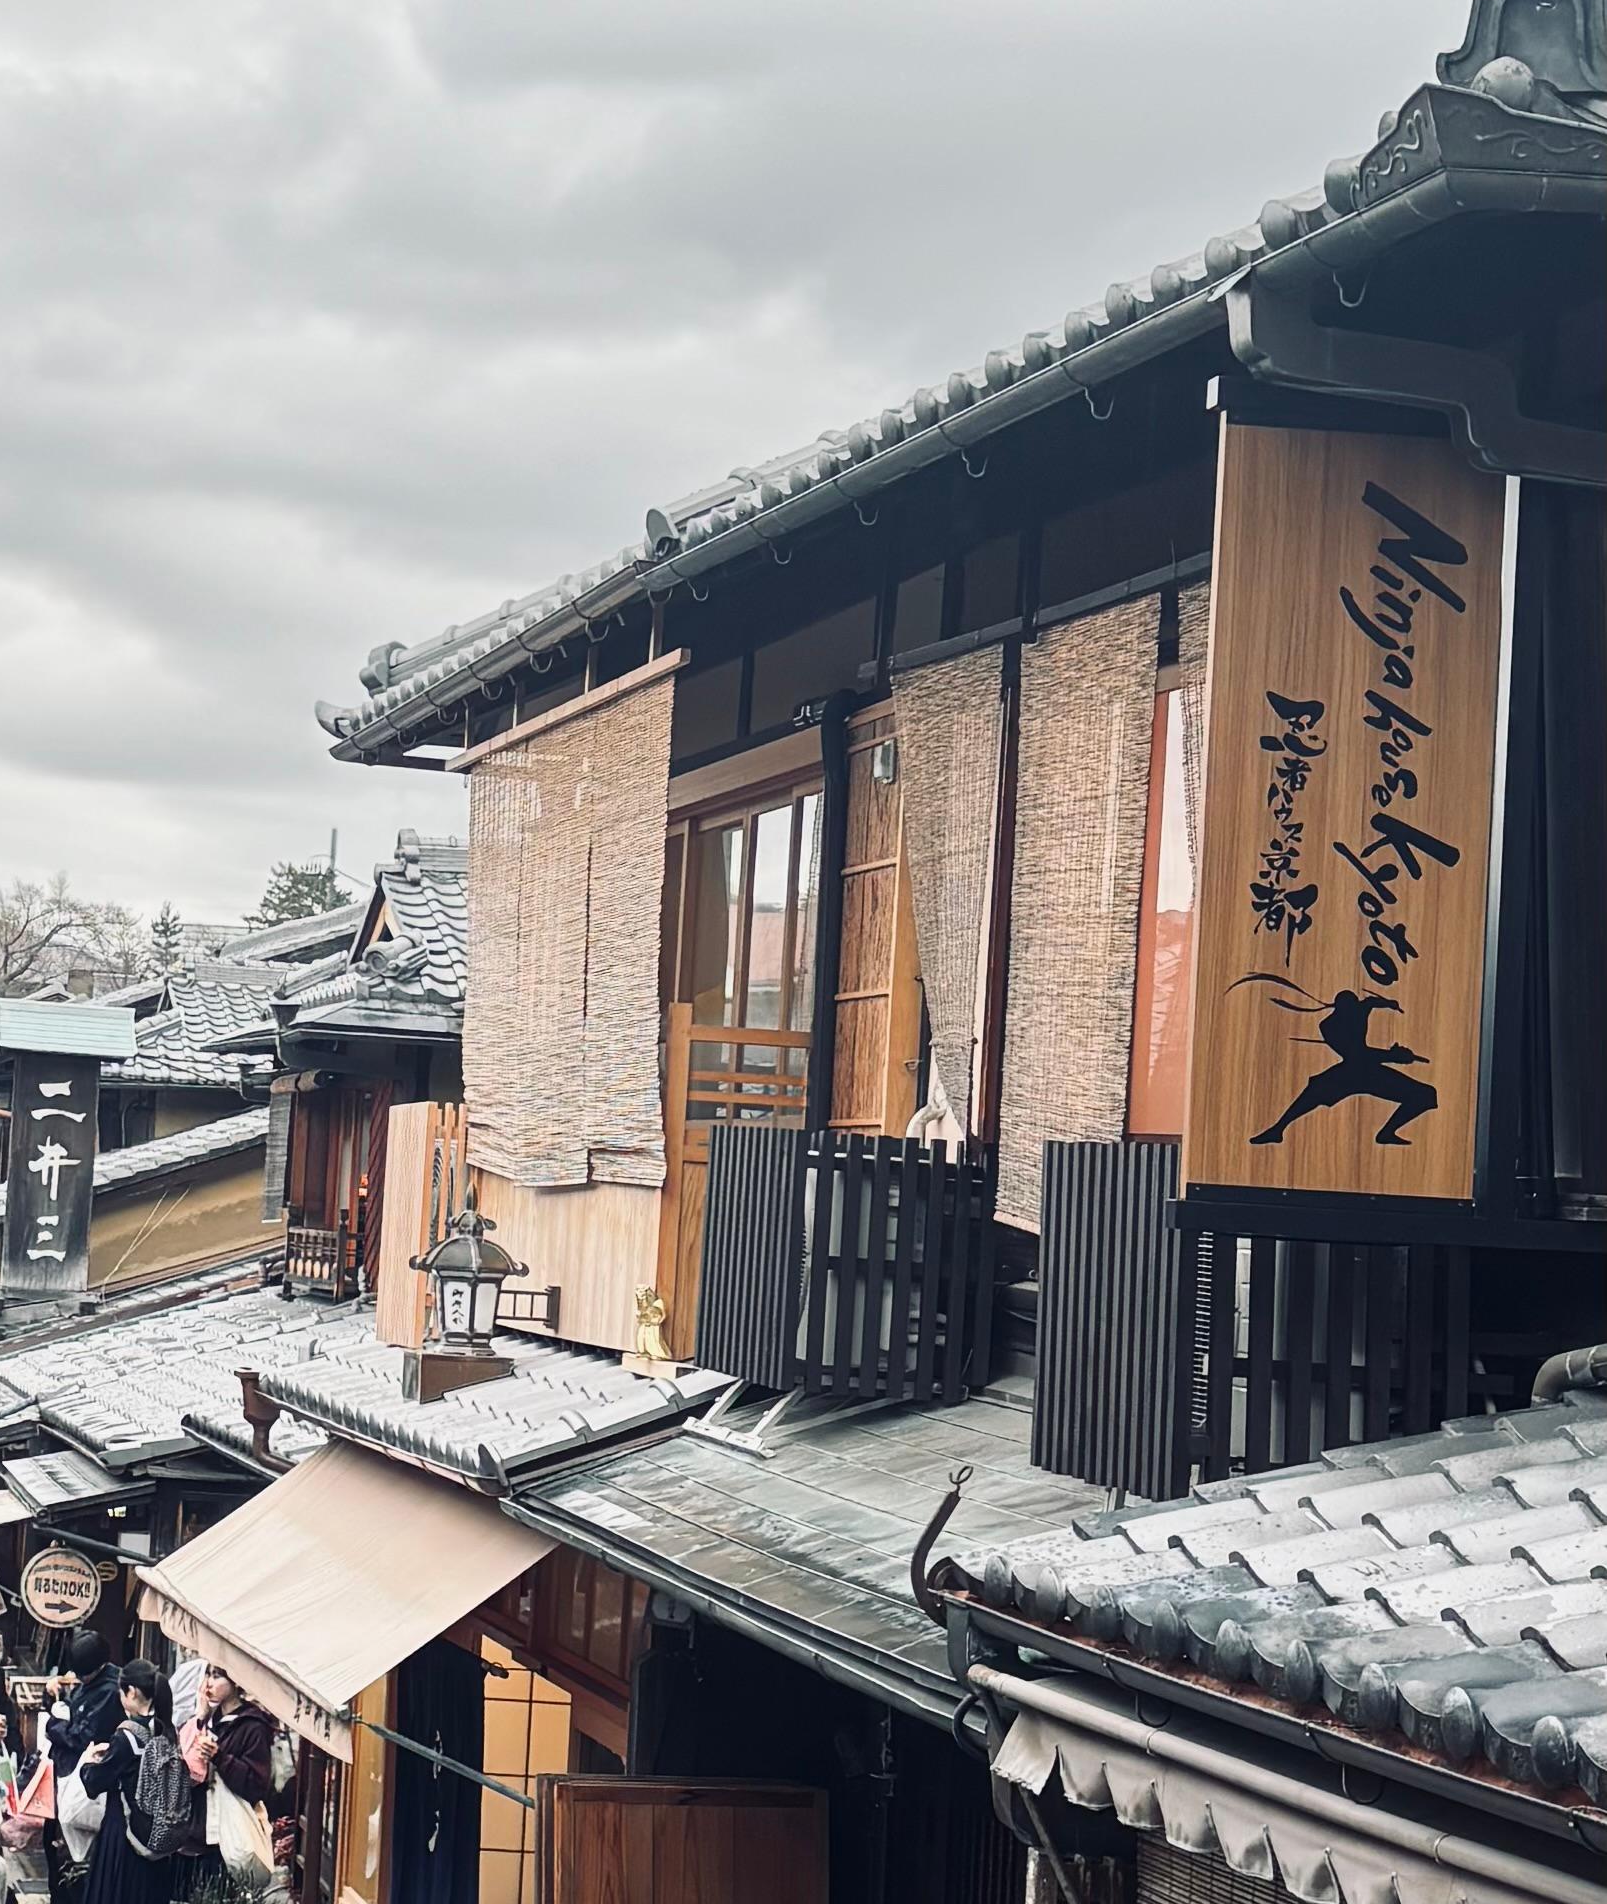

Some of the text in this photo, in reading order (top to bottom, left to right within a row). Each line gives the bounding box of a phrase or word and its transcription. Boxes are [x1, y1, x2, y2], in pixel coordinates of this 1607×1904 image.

[1340, 481, 1468, 689] Ninja
[1250, 691, 1327, 968] 忍者ハウス京都
[1363, 689, 1433, 808] house
[27, 1081, 86, 1262] 二井三
